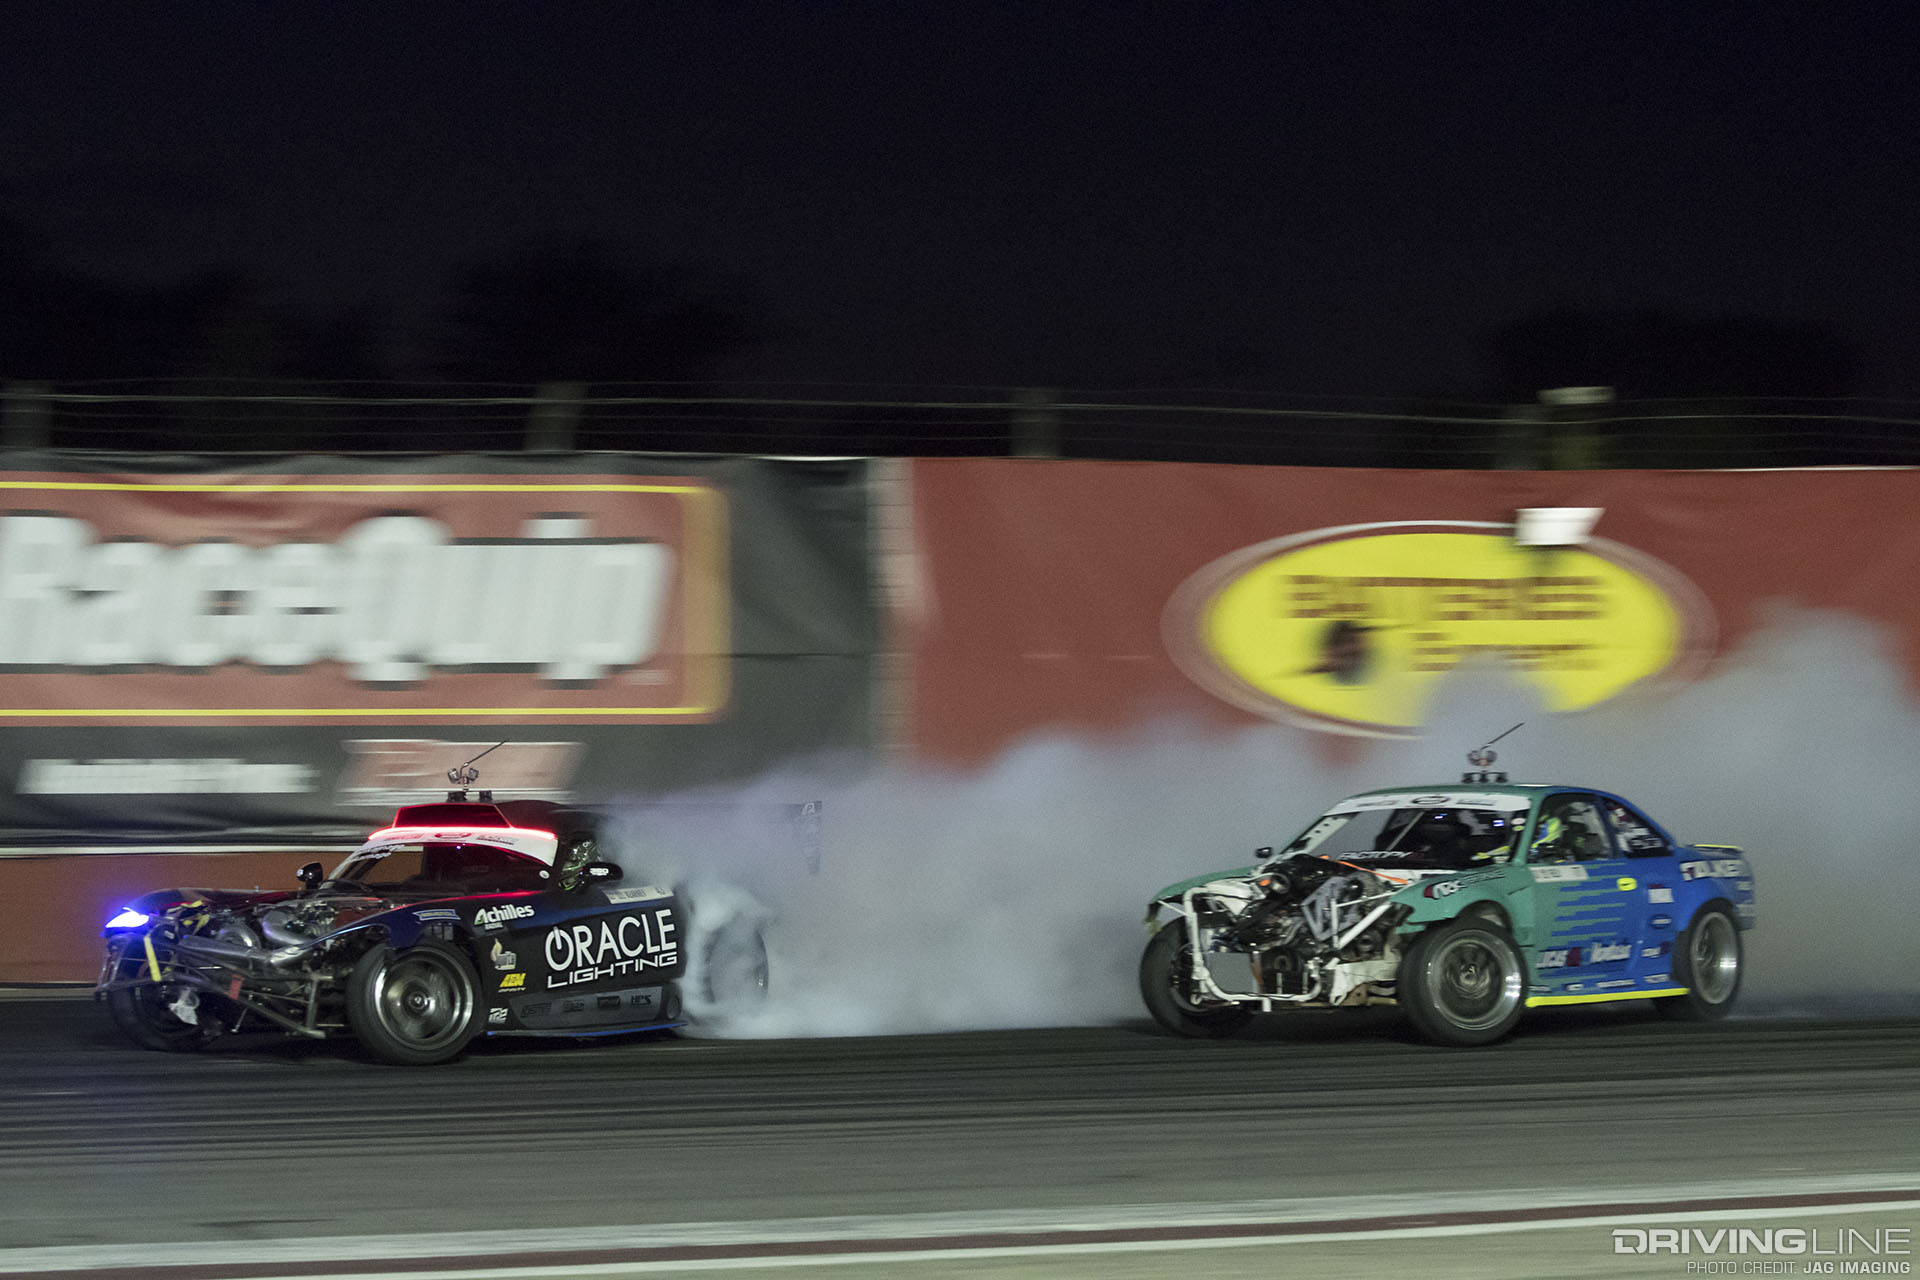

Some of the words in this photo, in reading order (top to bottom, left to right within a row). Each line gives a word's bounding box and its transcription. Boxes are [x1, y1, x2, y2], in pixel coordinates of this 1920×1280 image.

[474, 904, 535, 925] Achilles
[545, 909, 677, 971] ORACLE
[547, 951, 678, 988] LIGHTING
